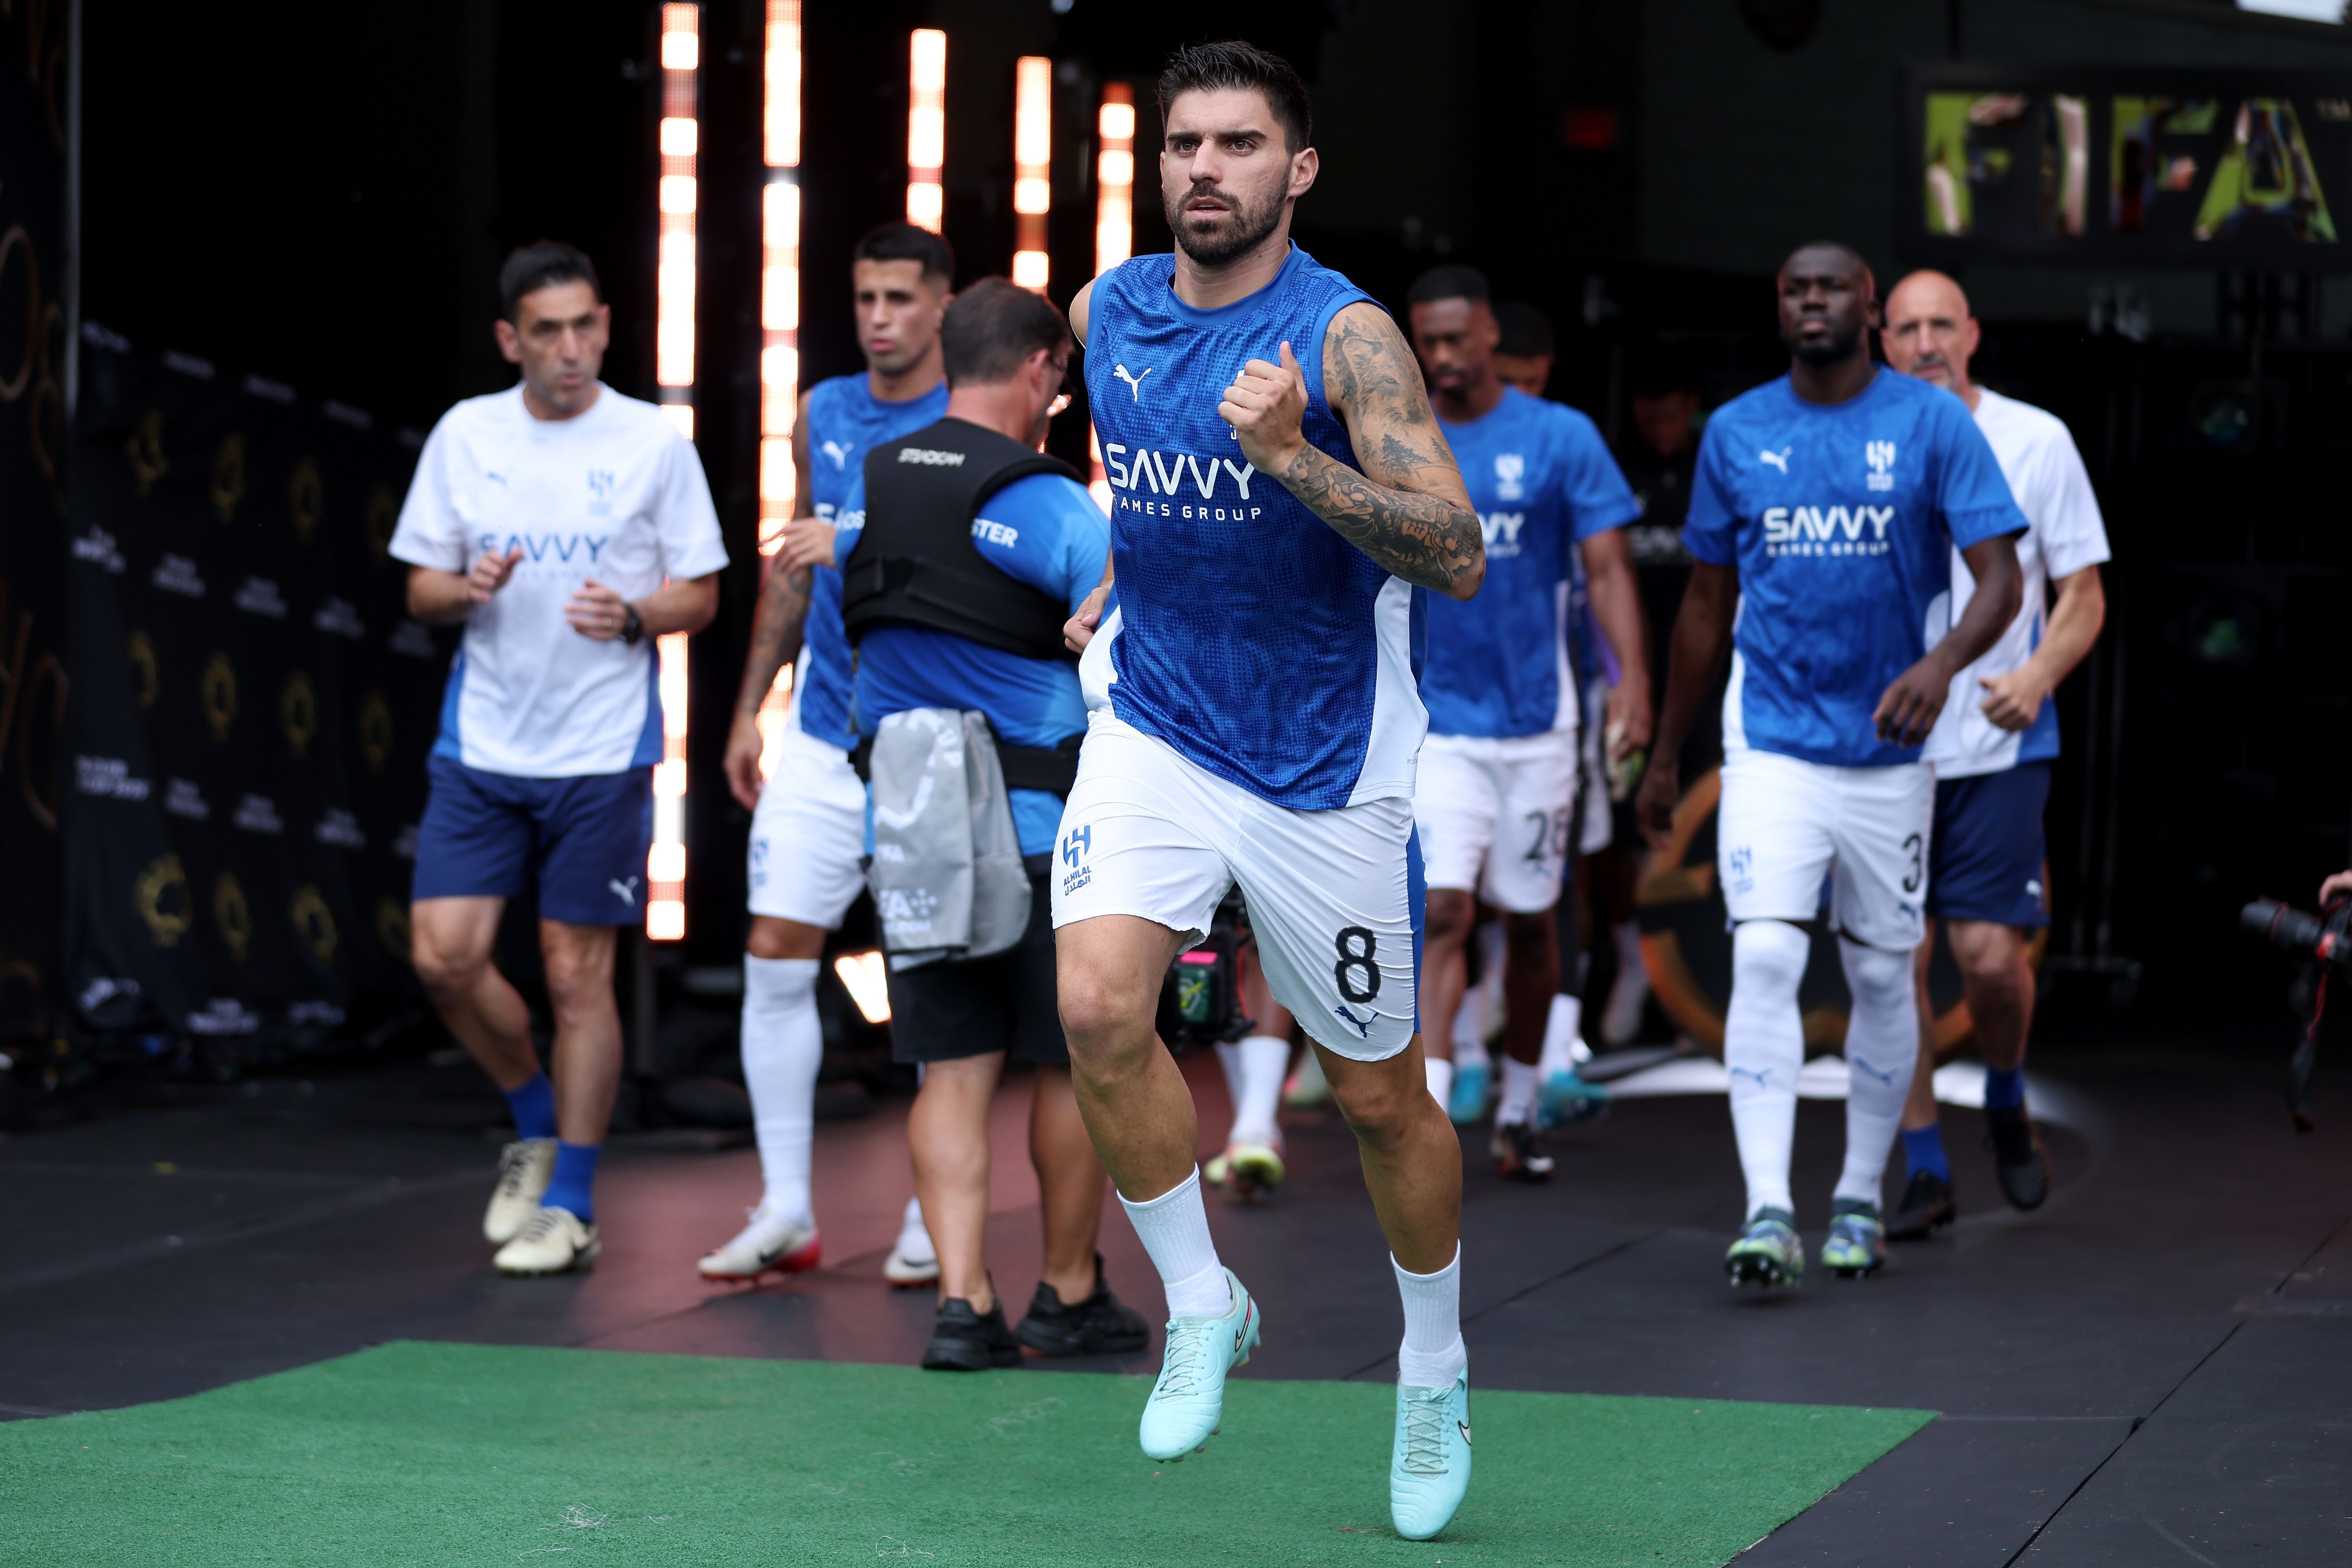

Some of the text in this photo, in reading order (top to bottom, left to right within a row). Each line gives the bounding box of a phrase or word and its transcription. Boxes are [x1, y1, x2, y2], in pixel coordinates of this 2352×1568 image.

[1925, 93, 2339, 243] FIFA
[1106, 443, 1255, 500] SAVVY
[1113, 494, 1261, 521] AMES GROUP
[1764, 505, 1895, 542] SAVVY
[1064, 865, 1092, 887] ALHILAL
[1065, 875, 1090, 896] الهلال
[1902, 832, 1921, 893] 3
[1334, 926, 1381, 1003] 8
